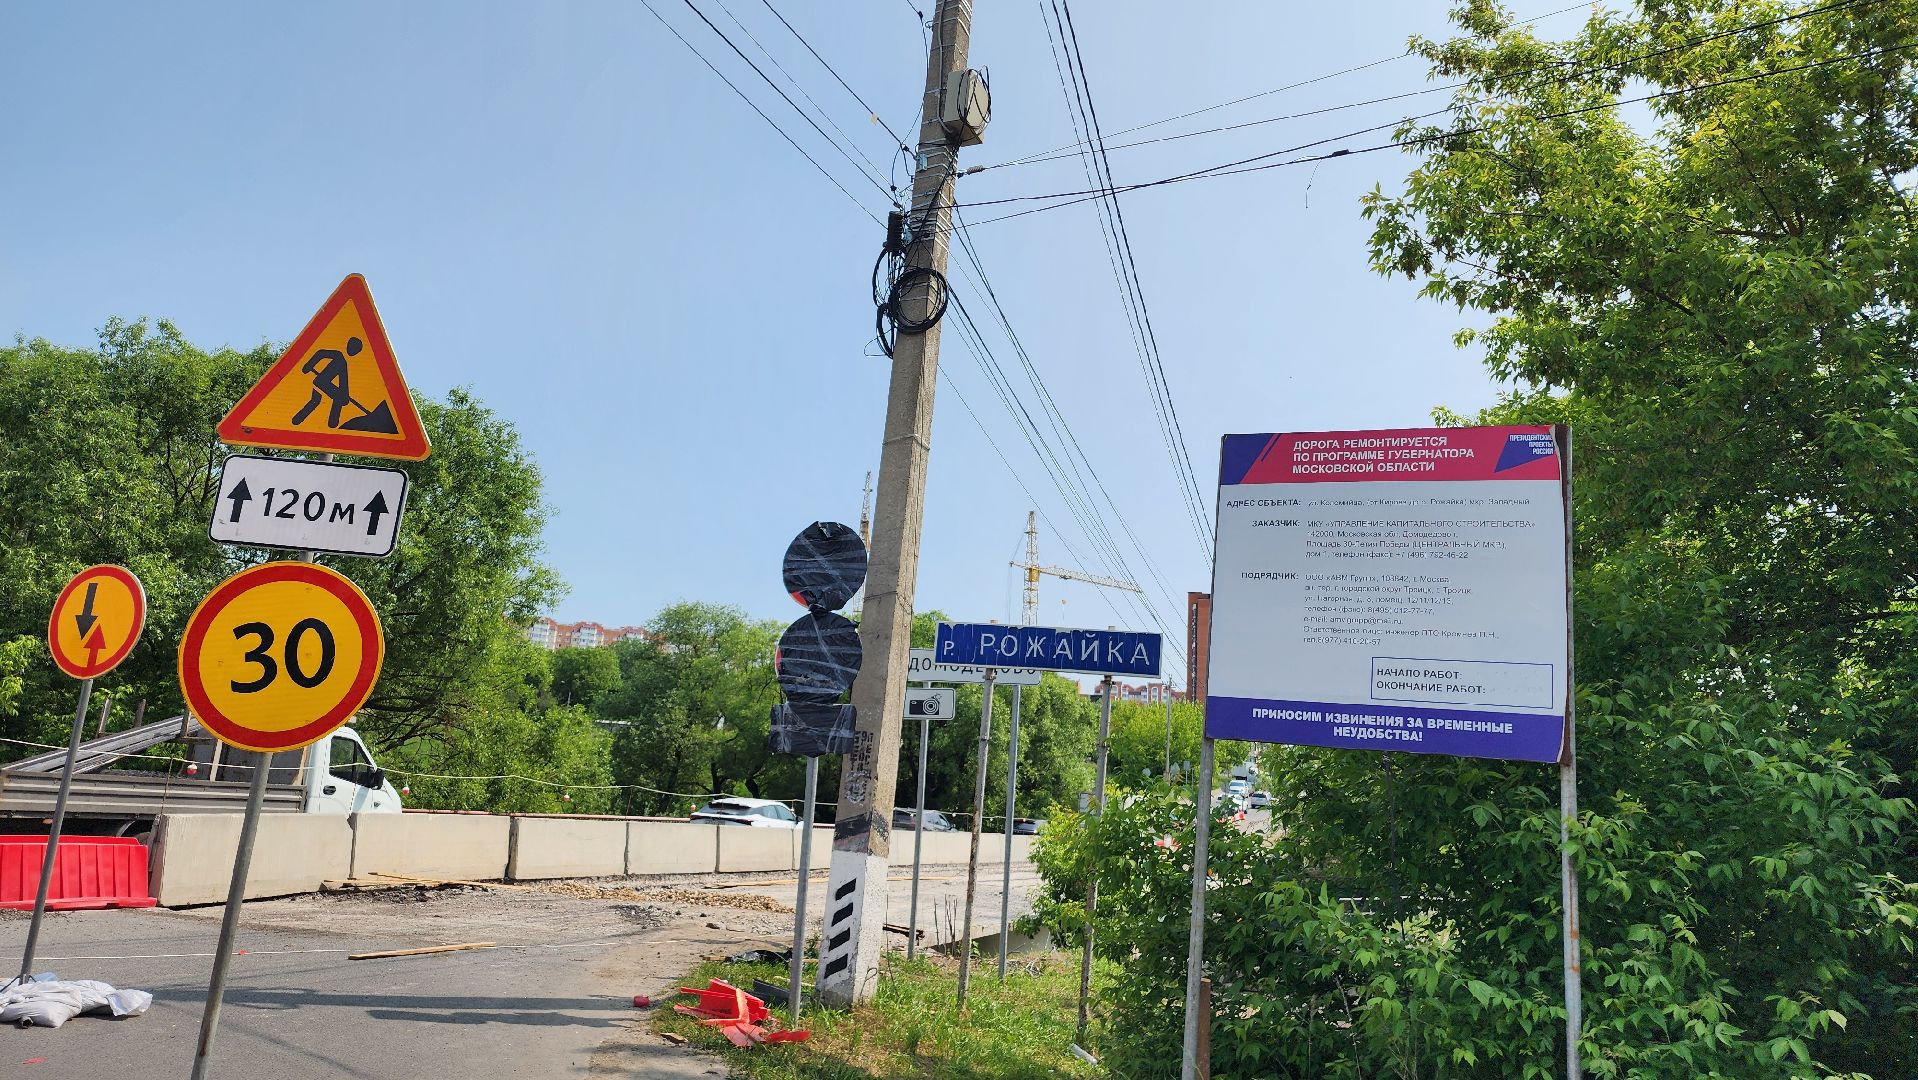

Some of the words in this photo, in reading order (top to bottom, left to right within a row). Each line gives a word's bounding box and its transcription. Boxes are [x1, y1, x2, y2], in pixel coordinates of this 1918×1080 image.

[1294, 439, 1340, 451] ДОРОГА
[1343, 436, 1447, 449] РЕМОНТИРУЕТСЯ
[1293, 451, 1310, 462] ПО
[1312, 449, 1385, 462] ПРОГРАММЕ
[1387, 447, 1475, 460] ГУБЕРНАТОРА
[1292, 461, 1374, 474] МОСКОВСКОЙ
[1377, 462, 1435, 473] ОБЛАСТИ
[1226, 499, 1255, 508] АДРЕС
[1257, 499, 1301, 507] ОБЪЕКТА:
[1307, 520, 1323, 528] МКУ
[1386, 520, 1454, 528] КАПИТАЛЬНОГО
[1241, 571, 1299, 581] ПОДРЯДЧИК:
[230, 616, 336, 694] 30
[980, 632, 1150, 666] РОЖАЙКА
[1376, 668, 1421, 678] НАЧАЛО
[1424, 670, 1463, 680] РАБОТ:
[1376, 681, 1443, 692] ОКОНЧАНИЕ
[1446, 684, 1486, 694] РАБОТ:
[1252, 708, 1322, 722] ПРИНОСИМ
[1325, 712, 1404, 727] ИЗВИНЕНИЯ
[1406, 717, 1424, 728] ЗА
[1427, 718, 1513, 734] ВРЕМЕННЫЕ
[1333, 726, 1423, 742] НЕУДОБСТВА!
